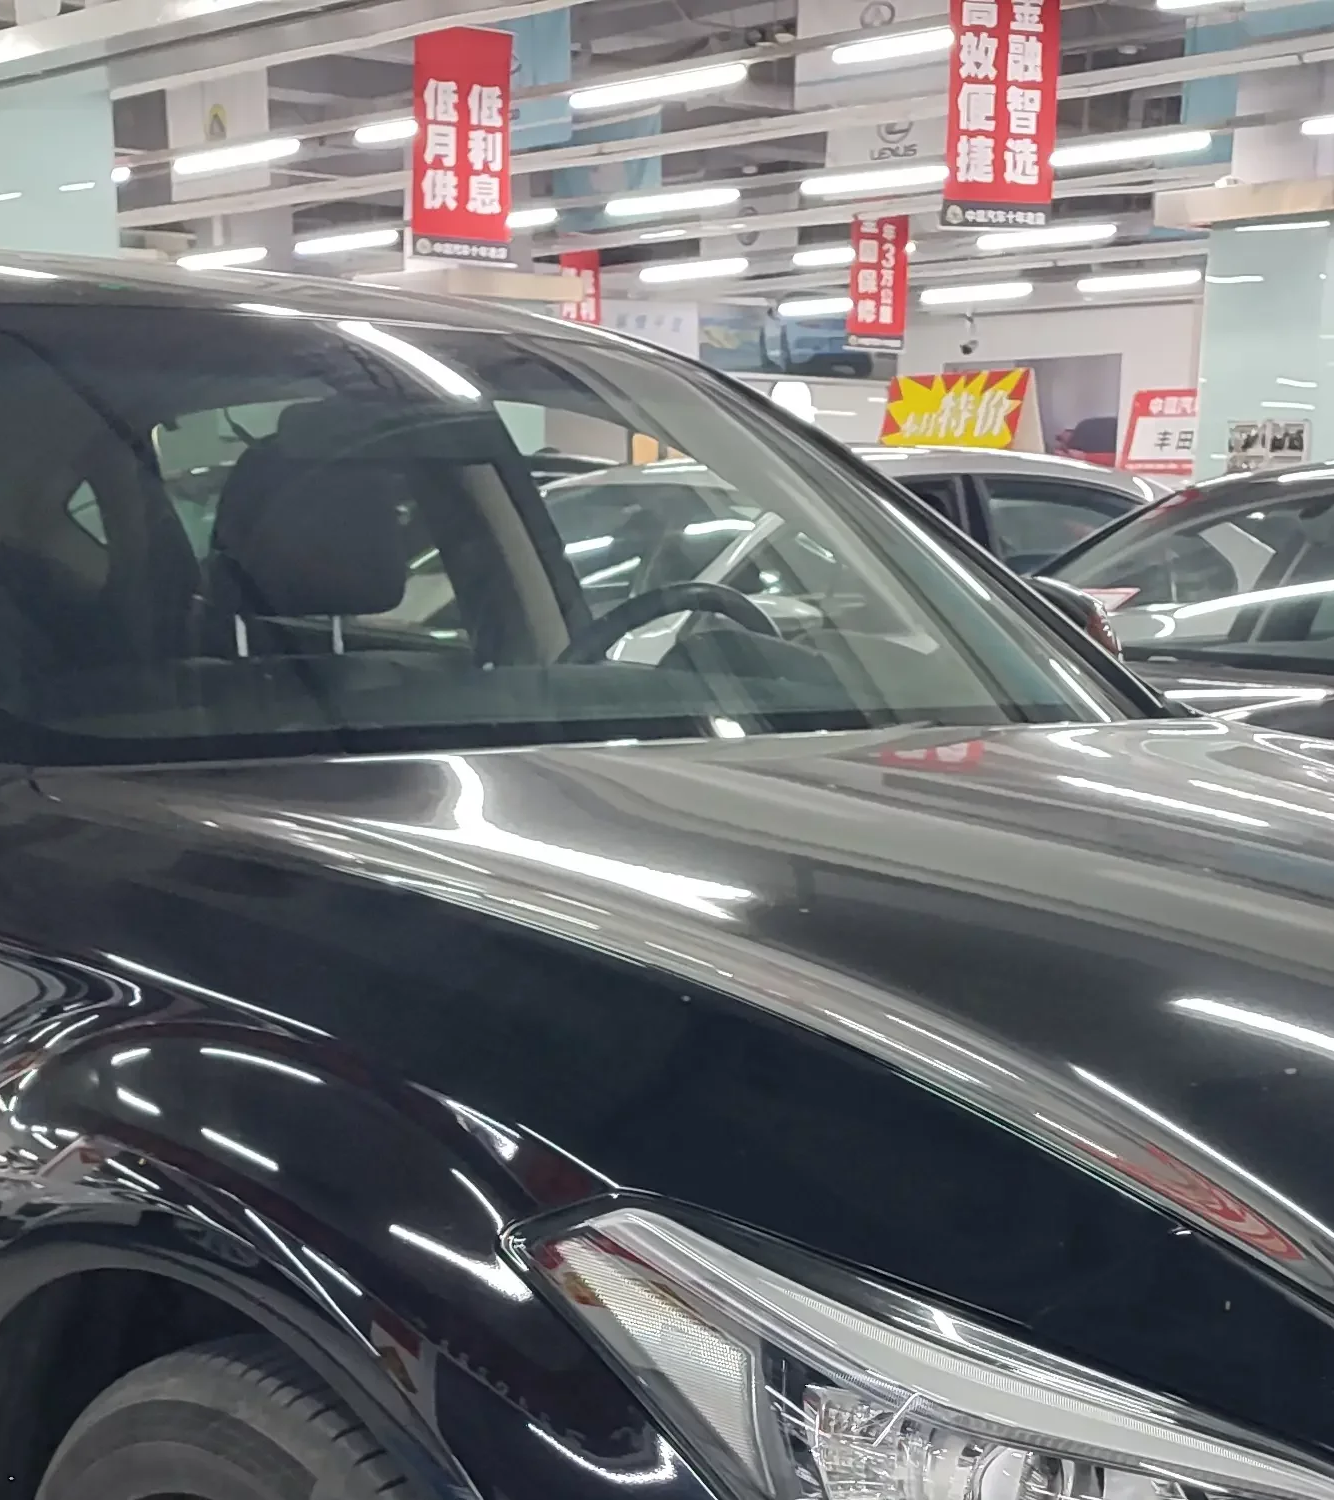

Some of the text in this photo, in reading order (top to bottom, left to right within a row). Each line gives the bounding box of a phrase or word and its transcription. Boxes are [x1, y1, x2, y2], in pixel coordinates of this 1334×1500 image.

[422, 78, 459, 212] 低月供
[466, 84, 503, 215] 低利息
[869, 143, 919, 161] LEXUS
